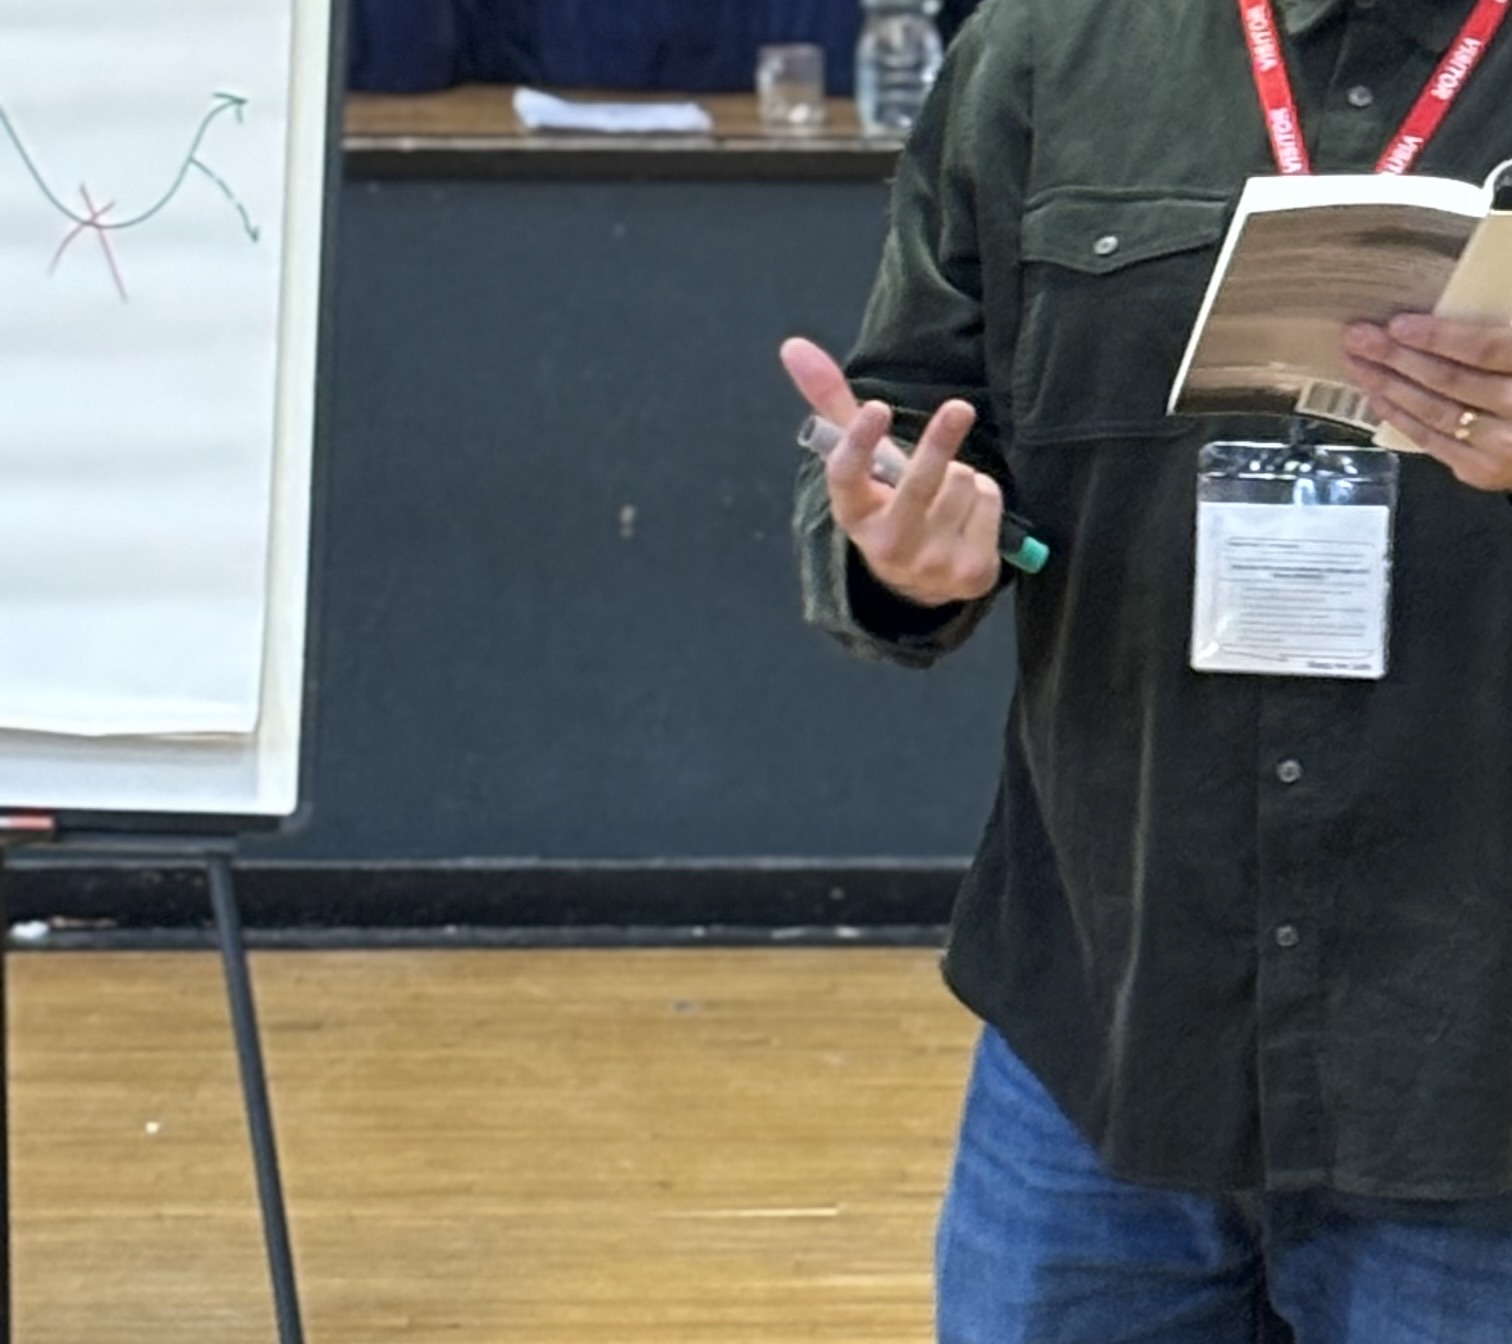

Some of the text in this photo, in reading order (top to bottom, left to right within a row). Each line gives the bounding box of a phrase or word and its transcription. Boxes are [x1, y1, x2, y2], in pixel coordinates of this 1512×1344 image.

[1247, 6, 1278, 72] VISITOR
[1431, 37, 1482, 100] VISITOR
[1270, 107, 1302, 173] VISITOR
[1384, 135, 1424, 174] VISIT
